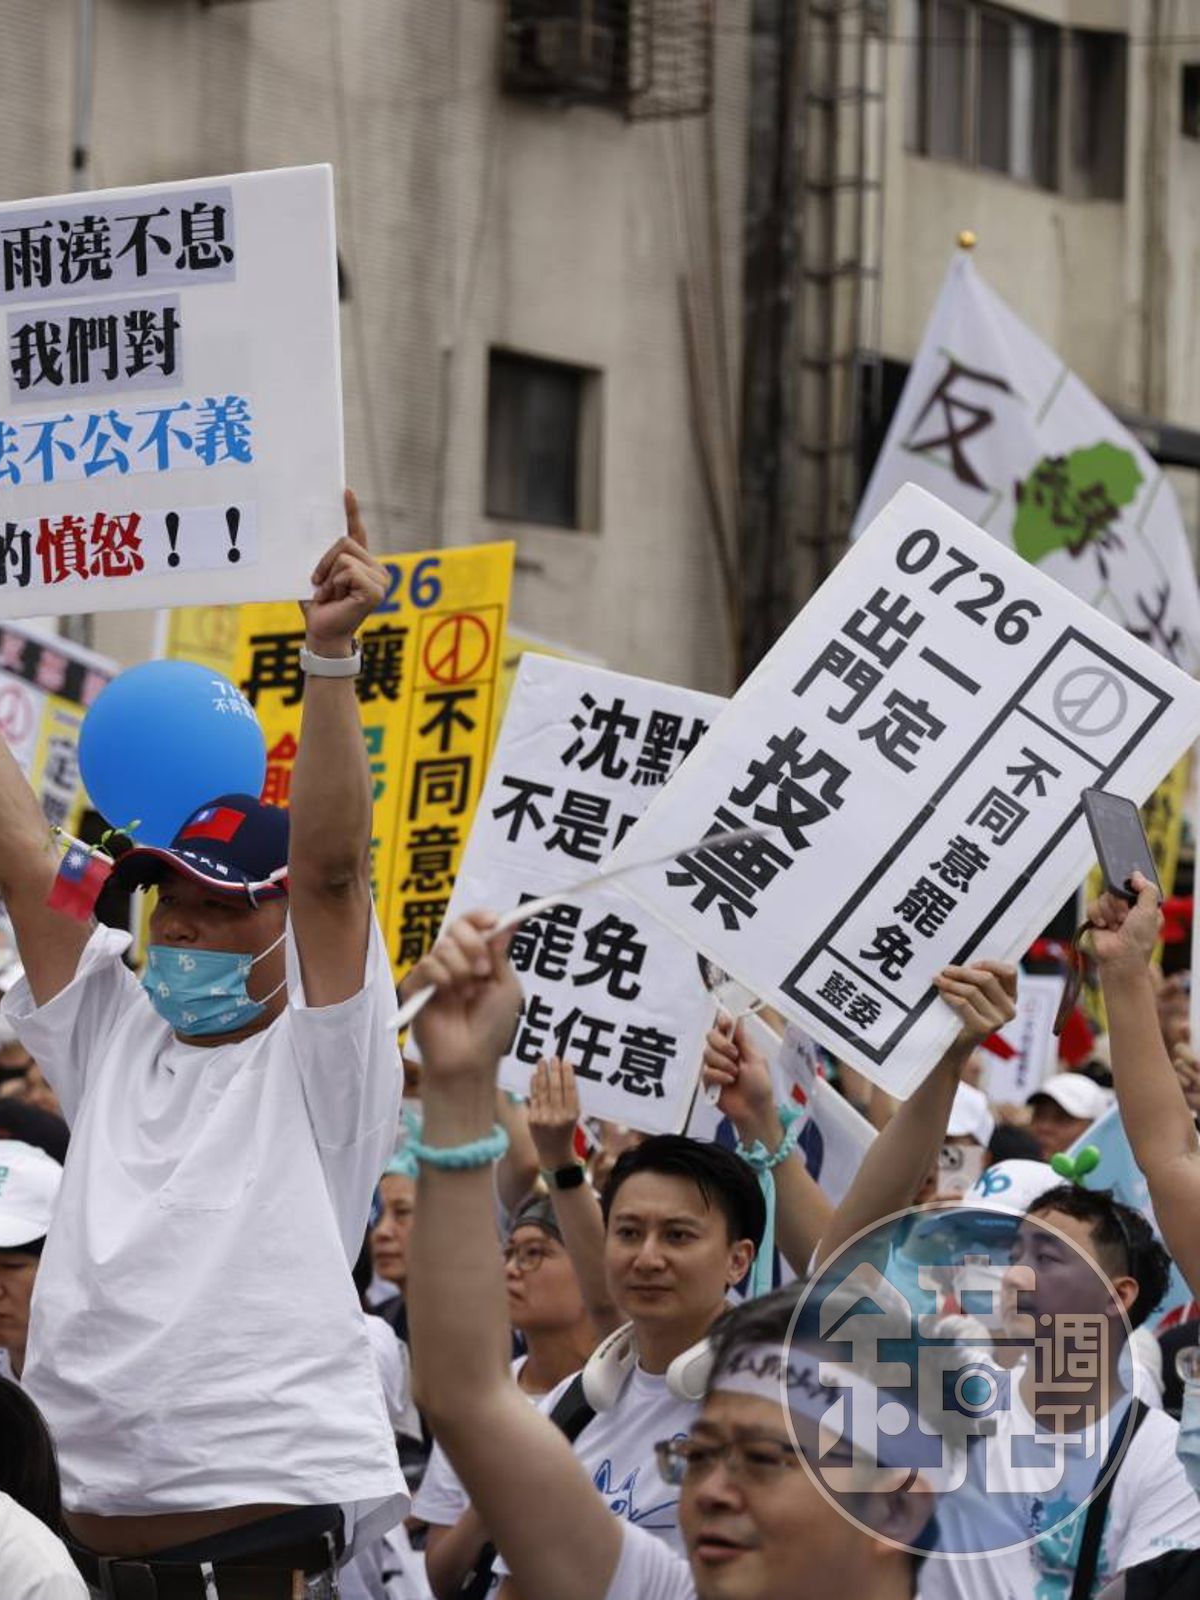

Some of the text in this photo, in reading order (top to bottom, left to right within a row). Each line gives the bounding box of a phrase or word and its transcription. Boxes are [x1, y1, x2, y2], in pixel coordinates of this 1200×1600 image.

[11, 307, 181, 390] 我們對
[373, 557, 442, 613] 26
[895, 528, 1042, 645] 0726
[665, 726, 852, 931] 投票
[859, 746, 1061, 982] 不同意罷免
[814, 970, 883, 1031] 藍委
